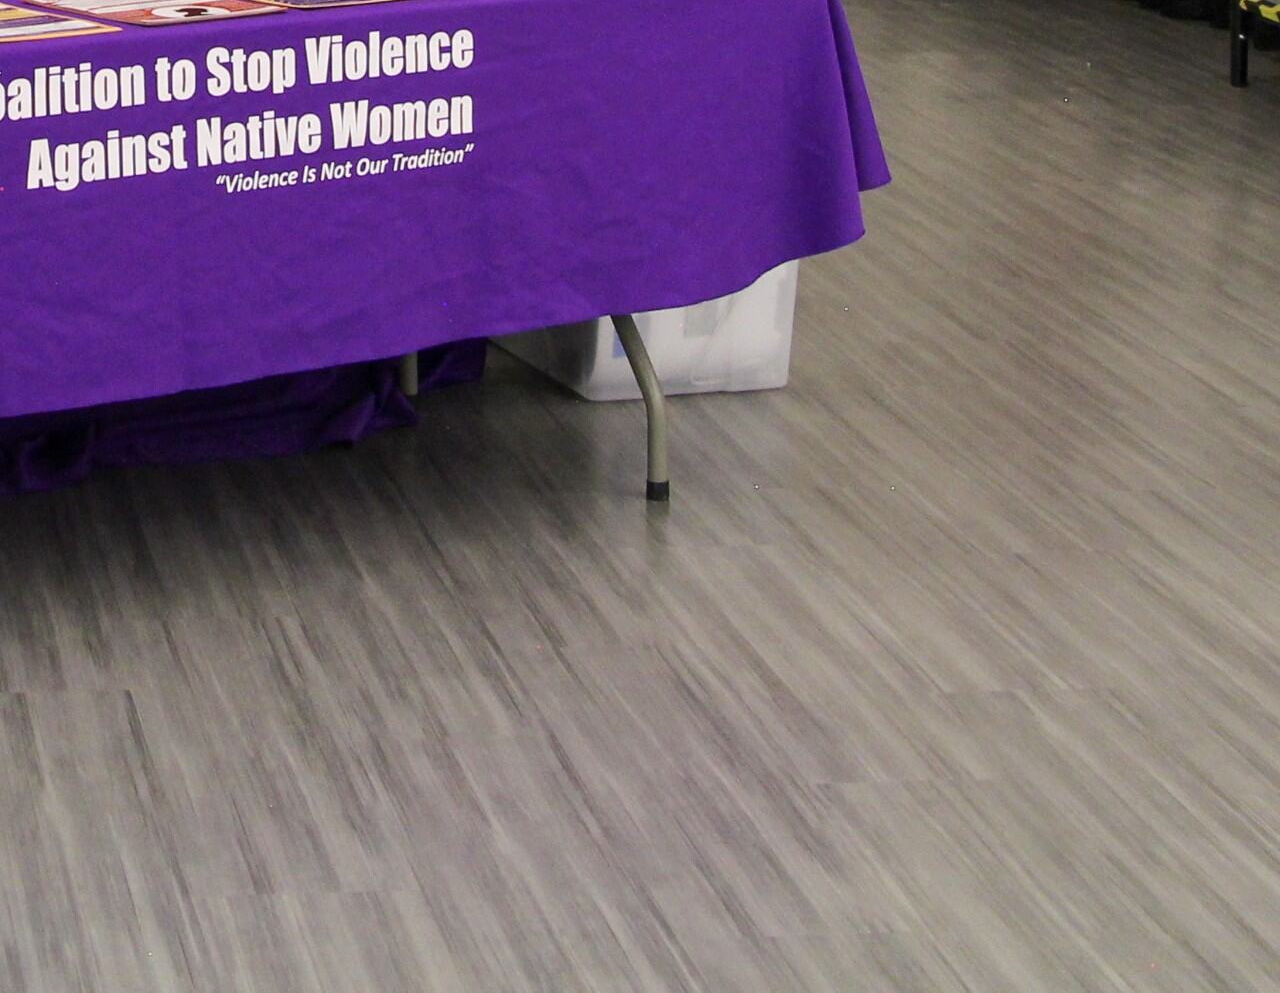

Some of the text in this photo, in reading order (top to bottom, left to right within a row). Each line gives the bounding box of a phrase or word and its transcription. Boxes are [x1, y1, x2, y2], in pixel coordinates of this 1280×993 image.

[155, 57, 196, 102] to
[206, 46, 297, 97] Stop
[305, 28, 475, 85] Violence
[26, 94, 474, 192] Against Native Women
[215, 142, 475, 194] “Violence Is Not Our Tradition”
